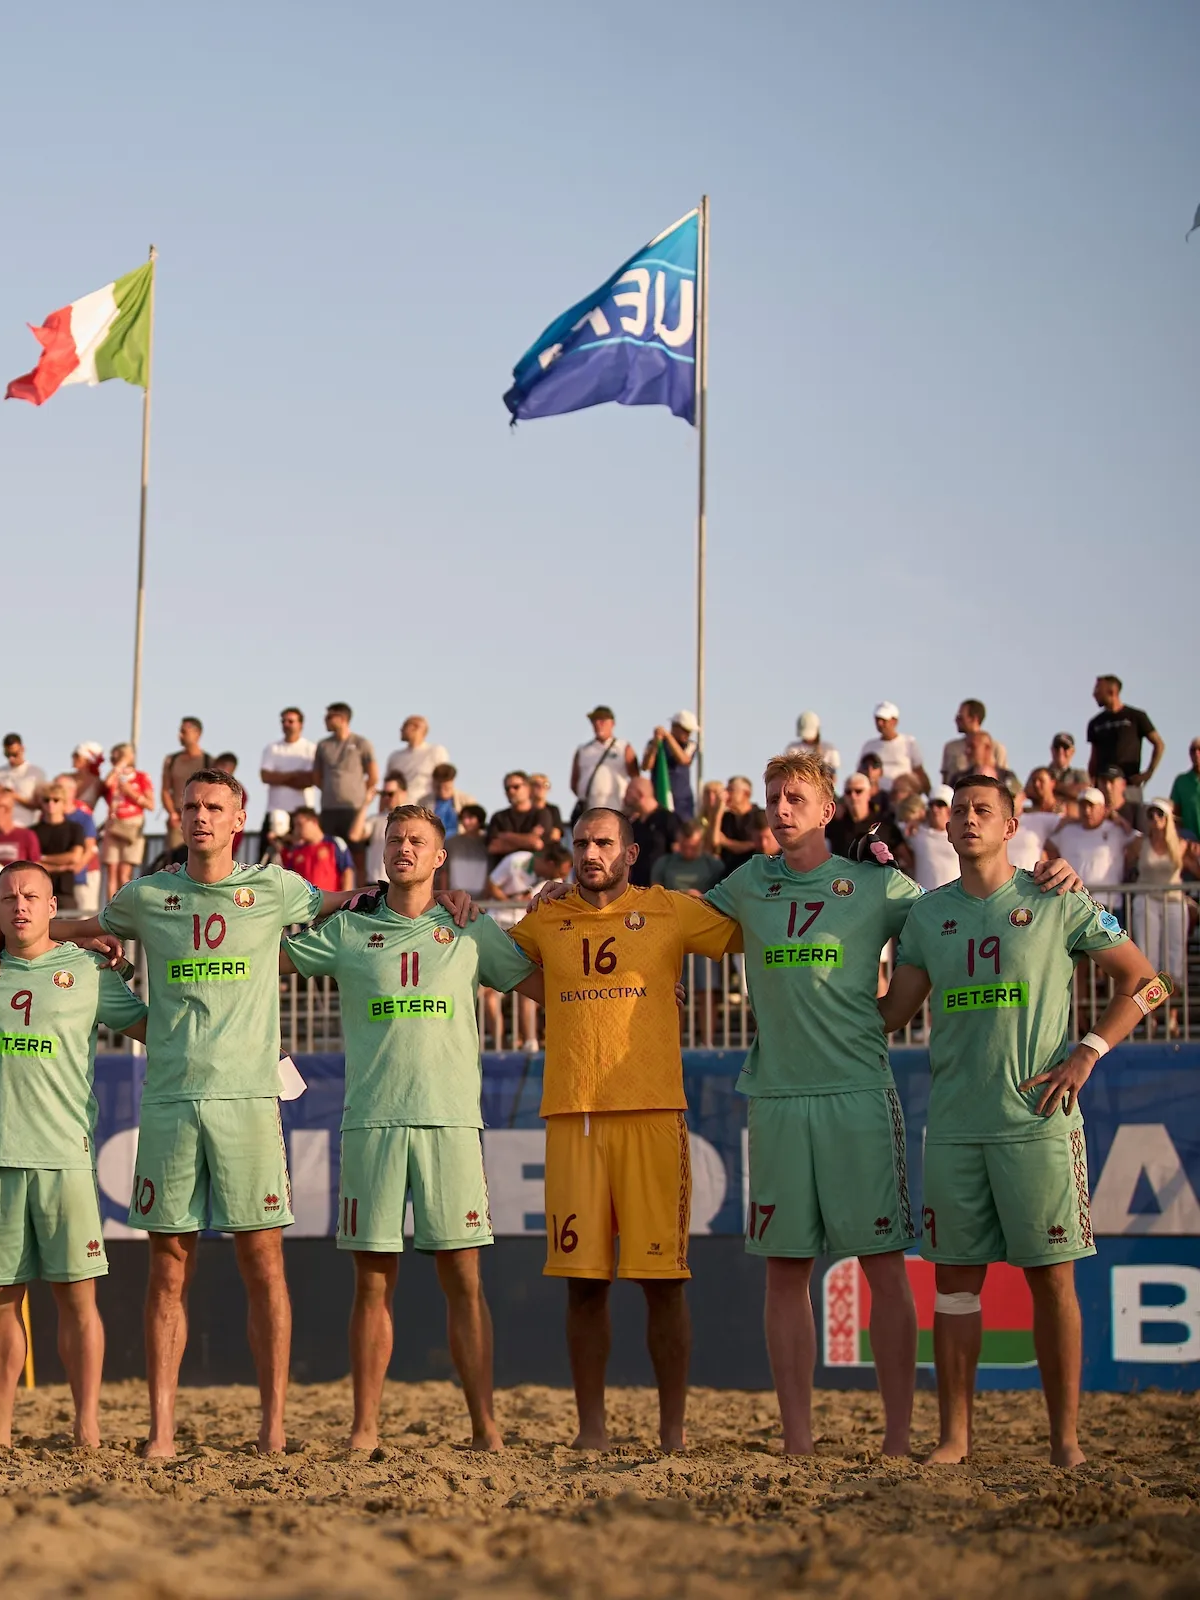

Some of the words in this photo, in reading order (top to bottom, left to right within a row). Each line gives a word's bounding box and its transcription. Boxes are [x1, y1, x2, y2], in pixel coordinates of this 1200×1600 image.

[192, 913, 227, 950] 10
[787, 901, 825, 938] 17
[400, 952, 419, 987] 11
[582, 936, 617, 976] 16
[967, 935, 1000, 977] 19
[10, 989, 33, 1026] 9
[560, 986, 647, 1003] БЕЛГОССТРАХ
[135, 1175, 155, 1215] 10
[344, 1197, 357, 1238] 11
[553, 1213, 578, 1253] 16
[749, 1201, 775, 1241] 17
